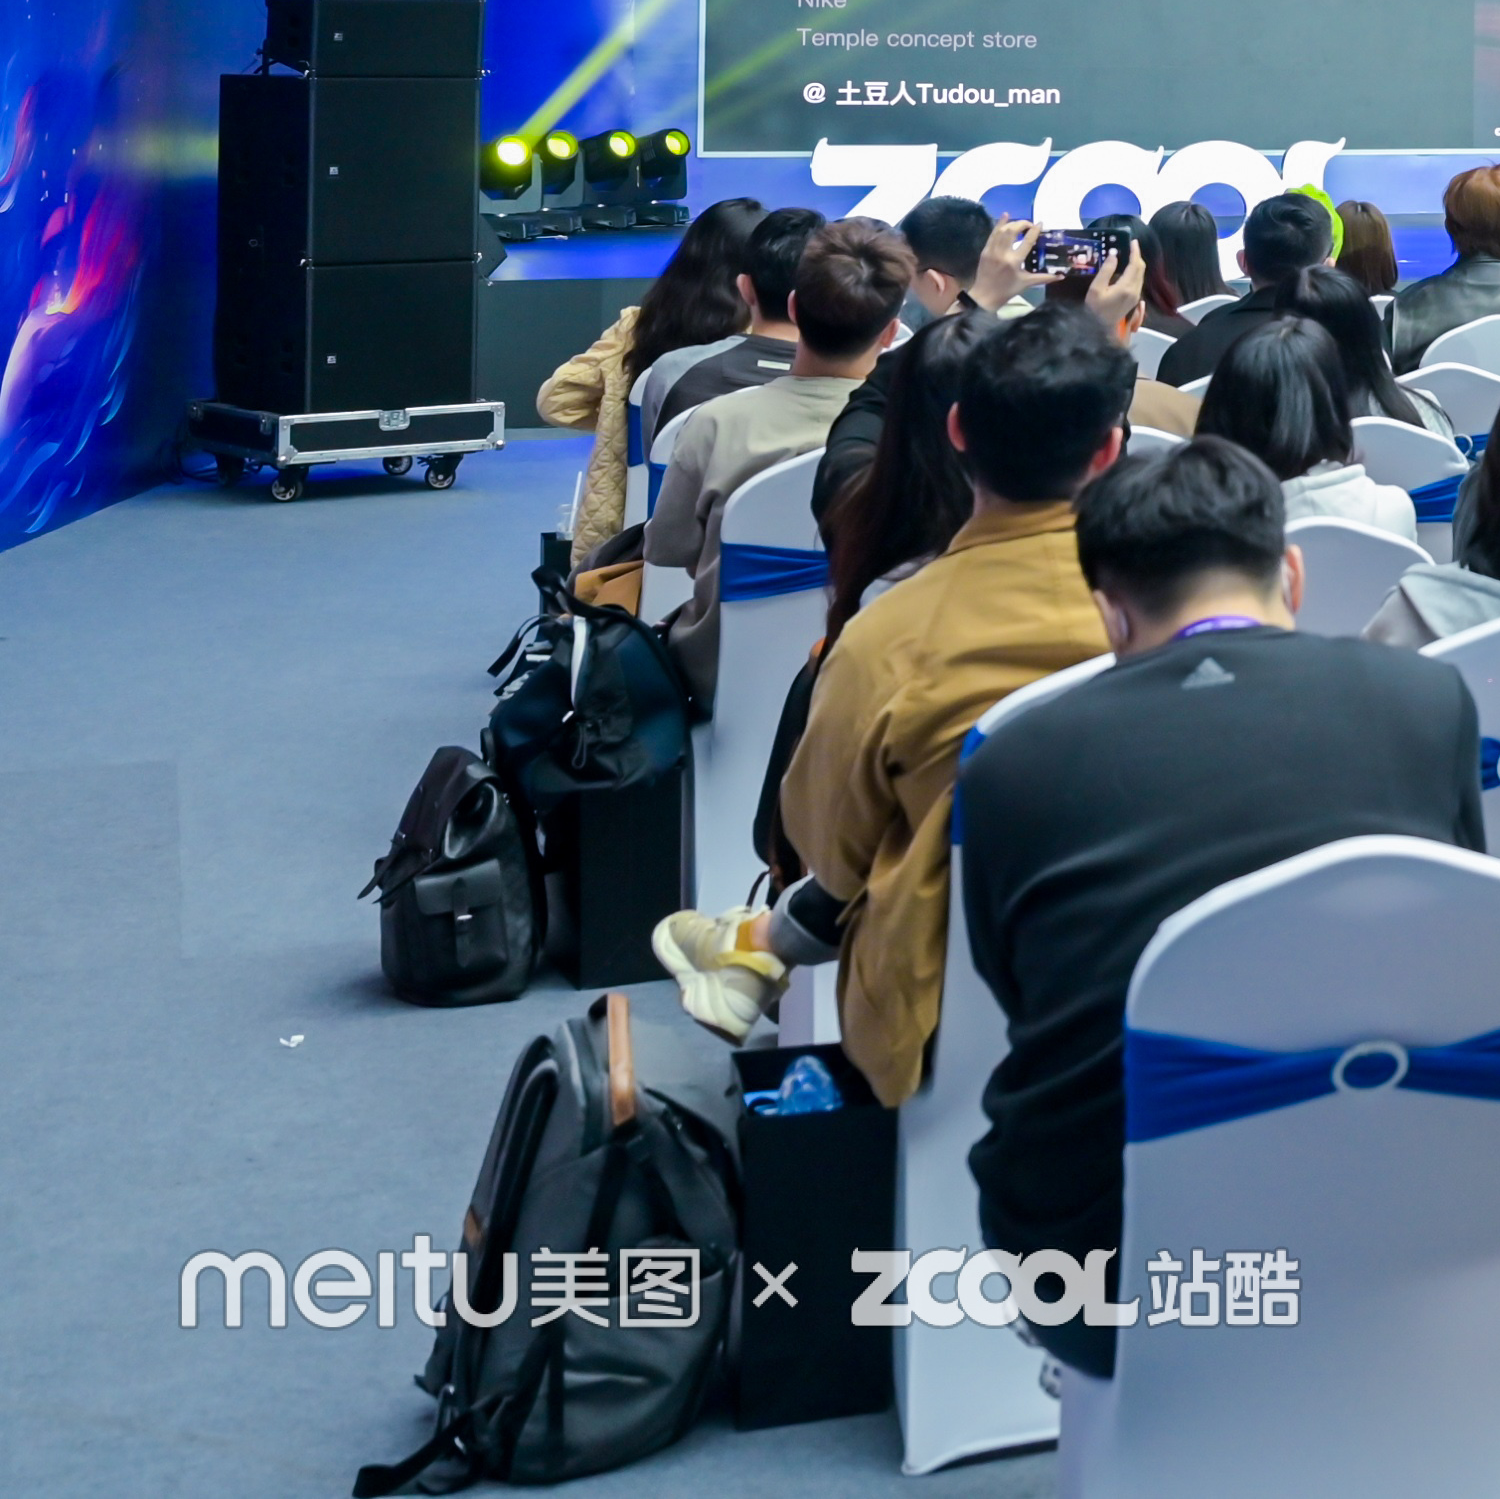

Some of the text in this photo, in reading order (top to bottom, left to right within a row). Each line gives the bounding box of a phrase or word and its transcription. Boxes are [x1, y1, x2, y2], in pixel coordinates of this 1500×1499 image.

[796, 27, 1037, 51] Temple concept store
[803, 82, 826, 103] @
